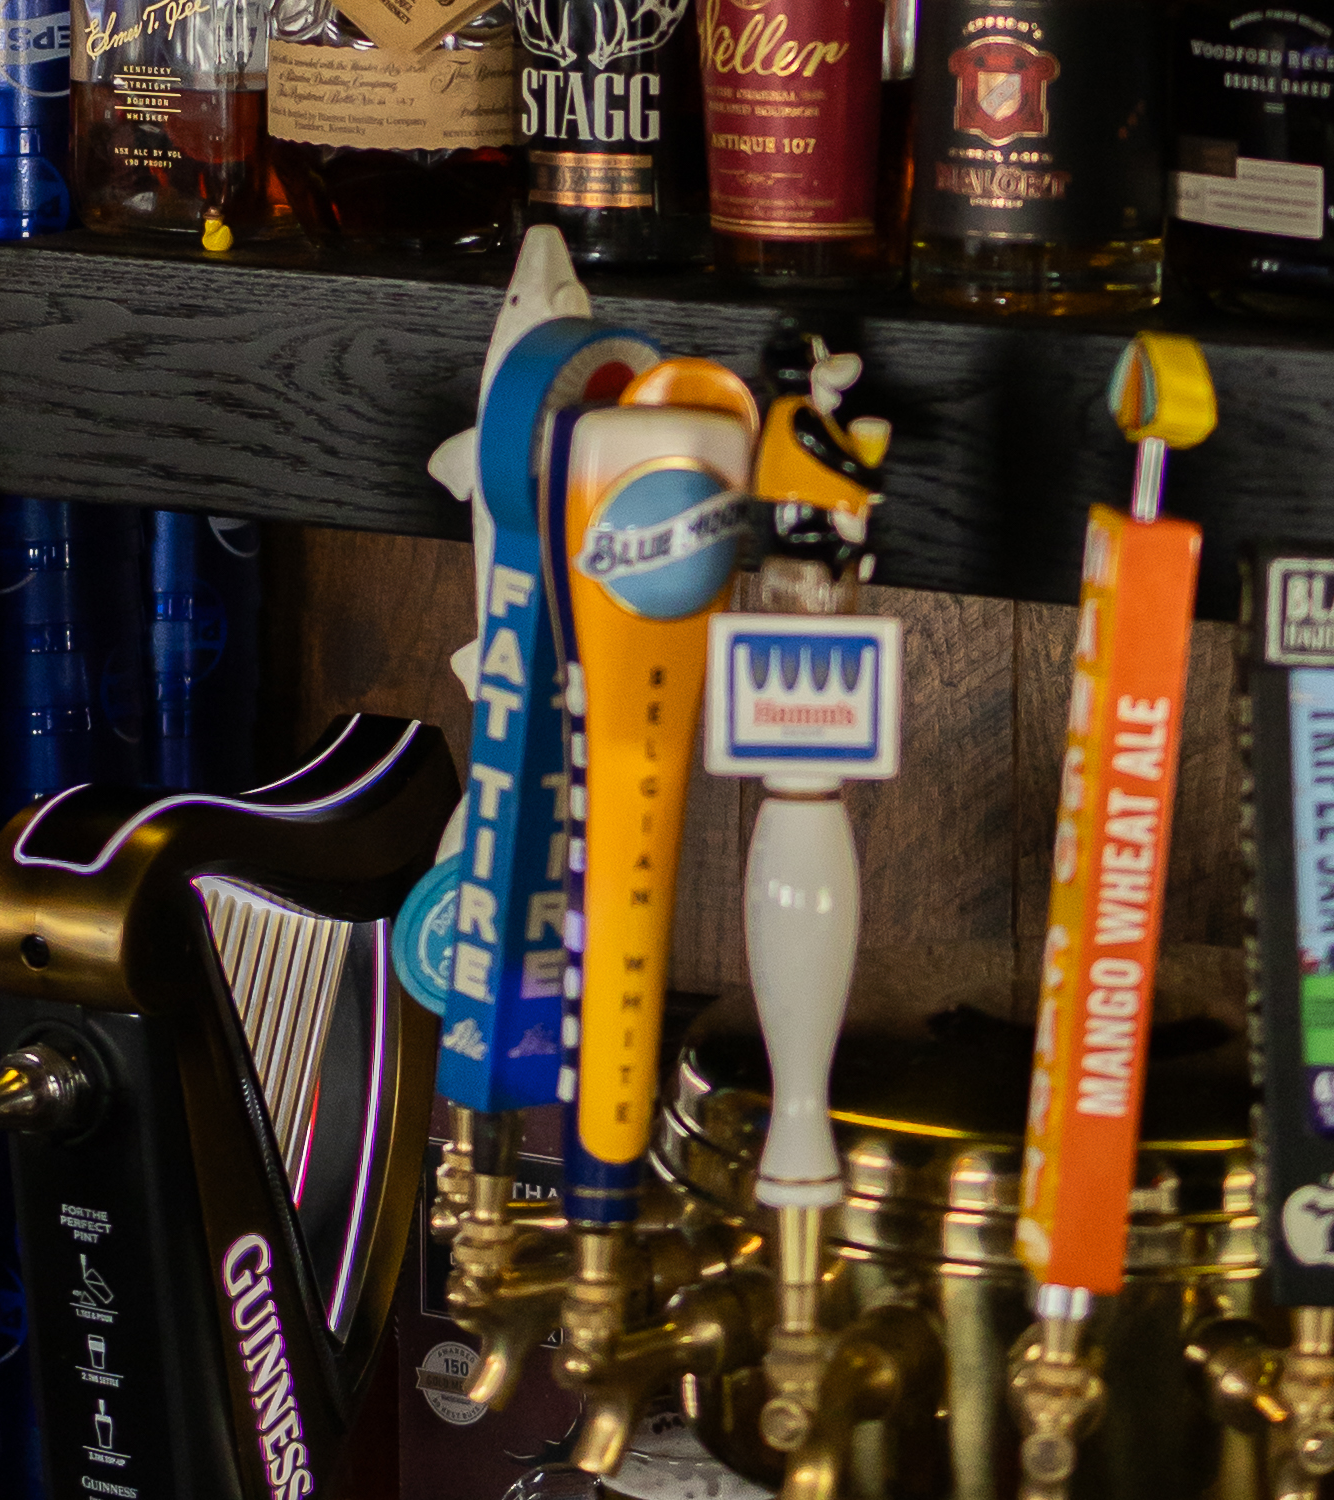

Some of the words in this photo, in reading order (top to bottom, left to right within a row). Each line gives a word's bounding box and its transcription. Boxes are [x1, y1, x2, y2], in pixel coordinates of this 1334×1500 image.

[84, 11, 143, 60] Elmer
[123, 65, 172, 75] KENTUCKY
[126, 97, 169, 107] BOURBON
[126, 112, 169, 122] WHISKEY
[522, 67, 660, 143] STAGG
[134, 149, 148, 157] ALC
[710, 133, 775, 154] ANTIQUE
[782, 138, 817, 154] 107
[588, 530, 674, 574] BLUE
[477, 564, 536, 742] FAT
[1112, 694, 1171, 782] ALE
[630, 665, 665, 907] BELGIAN
[451, 761, 514, 1006] TIRE
[1094, 796, 1164, 948] WHEAT
[614, 955, 647, 1125] WHITE
[1077, 957, 1145, 1118] MANGO
[60, 1215, 112, 1234] PERFECT
[74, 1230, 99, 1244] PINT
[444, 1358, 470, 1377] 150
[81, 1475, 138, 1498] GUINNESS
